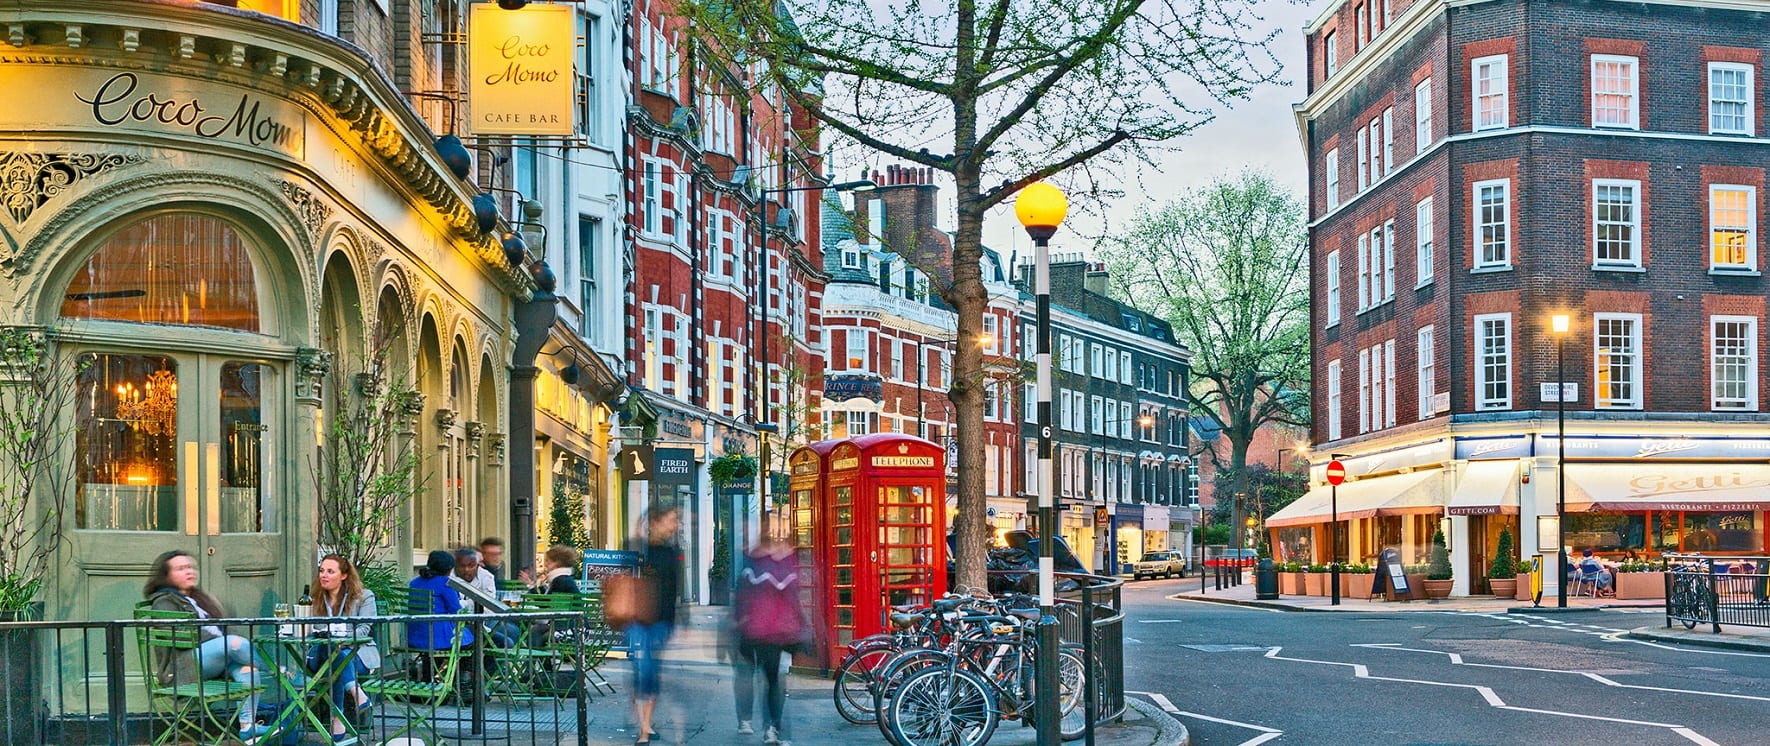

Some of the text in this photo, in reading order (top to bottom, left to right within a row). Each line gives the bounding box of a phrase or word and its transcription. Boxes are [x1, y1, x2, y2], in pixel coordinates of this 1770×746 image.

[494, 35, 551, 59] Coco
[485, 61, 559, 85] Momo
[73, 72, 205, 127] Coco
[484, 113, 559, 124] CAFE BAR
[825, 382, 857, 391] RINCE
[234, 420, 269, 431] Entrance
[1042, 426, 1051, 438] 6
[874, 457, 933, 465] TELEPHONE
[1626, 472, 1770, 498] Getti
[584, 552, 612, 560] NATURAL
